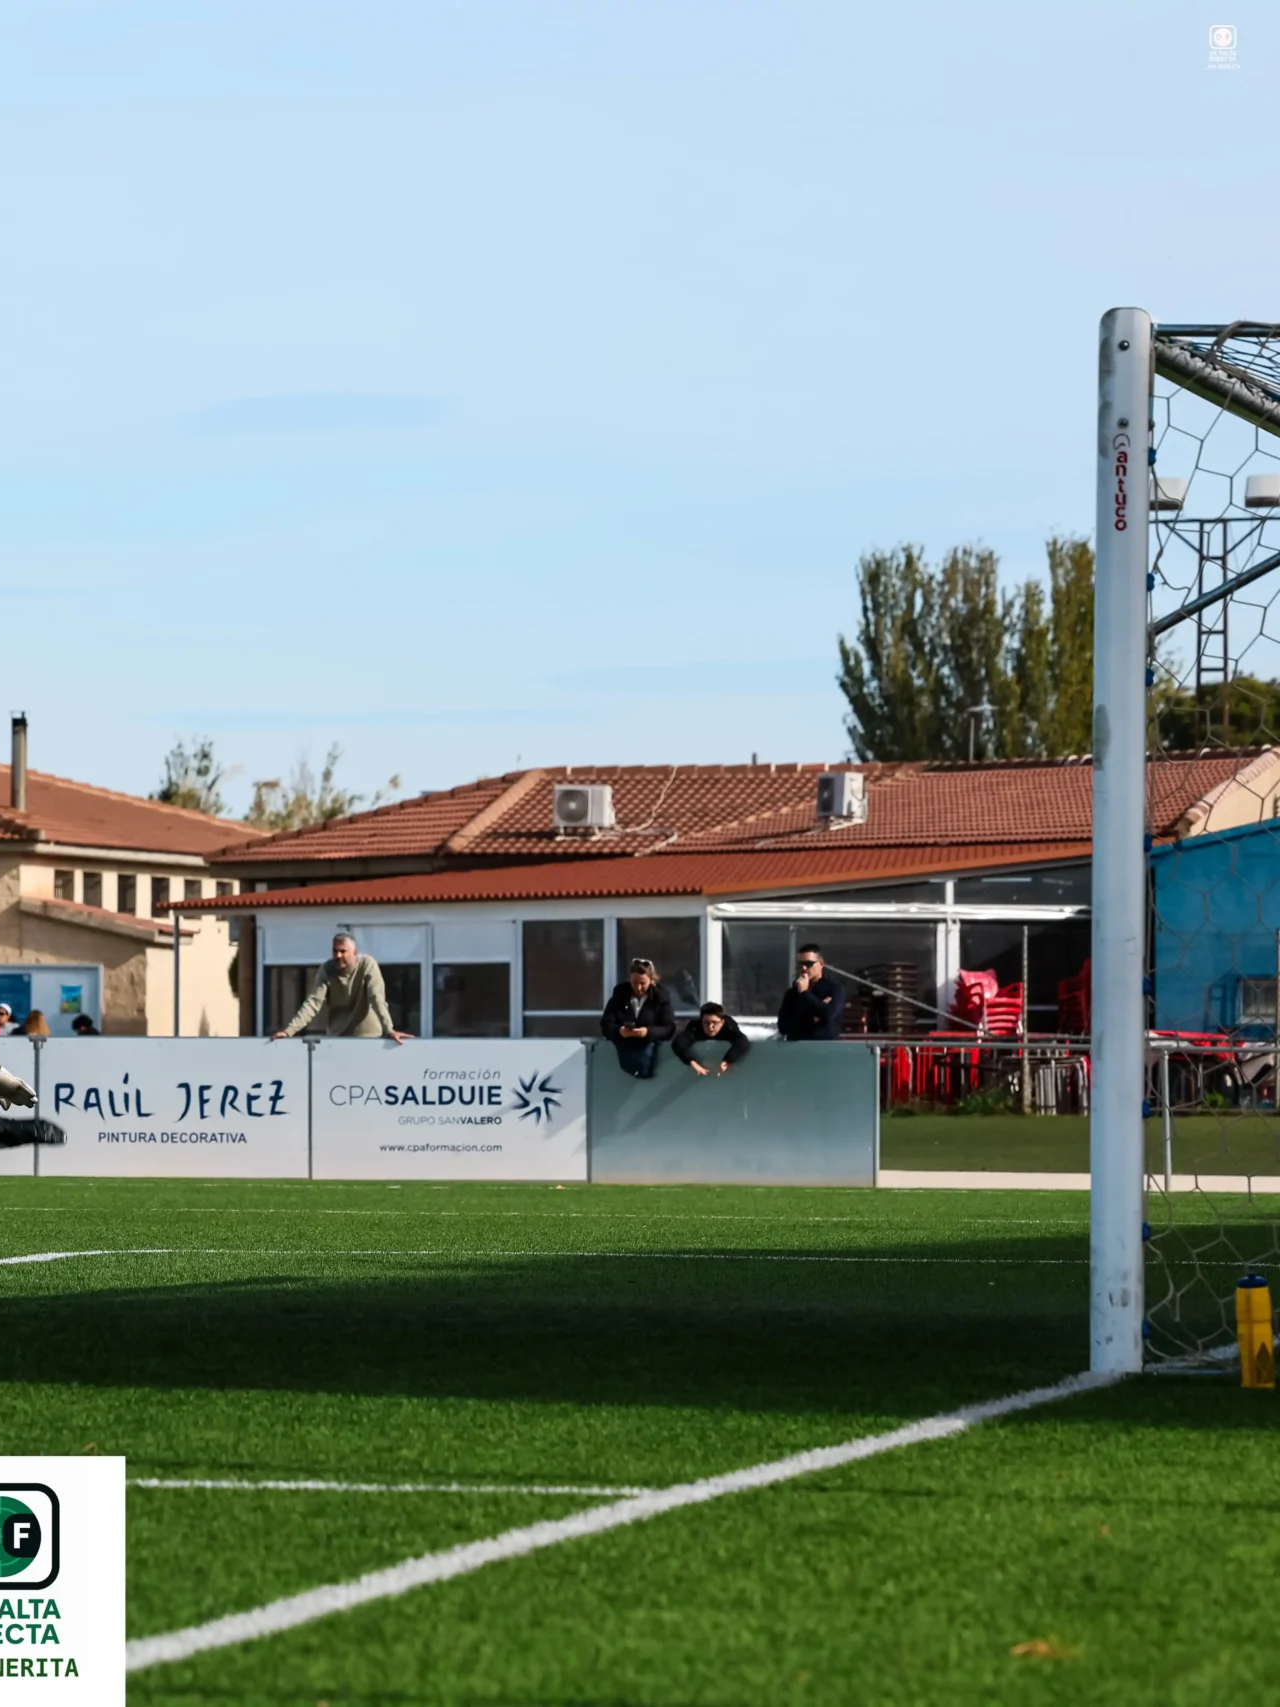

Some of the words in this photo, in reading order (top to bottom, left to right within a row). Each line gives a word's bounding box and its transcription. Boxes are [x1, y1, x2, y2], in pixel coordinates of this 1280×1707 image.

[422, 1068, 501, 1081] formación
[398, 1116, 435, 1125] GRUPO
[438, 1116, 503, 1125] SANVALERO
[98, 1132, 157, 1143] PINTURA
[161, 1132, 247, 1144] DECORATIVA
[379, 1143, 503, 1153] www.cpaformacion.com
